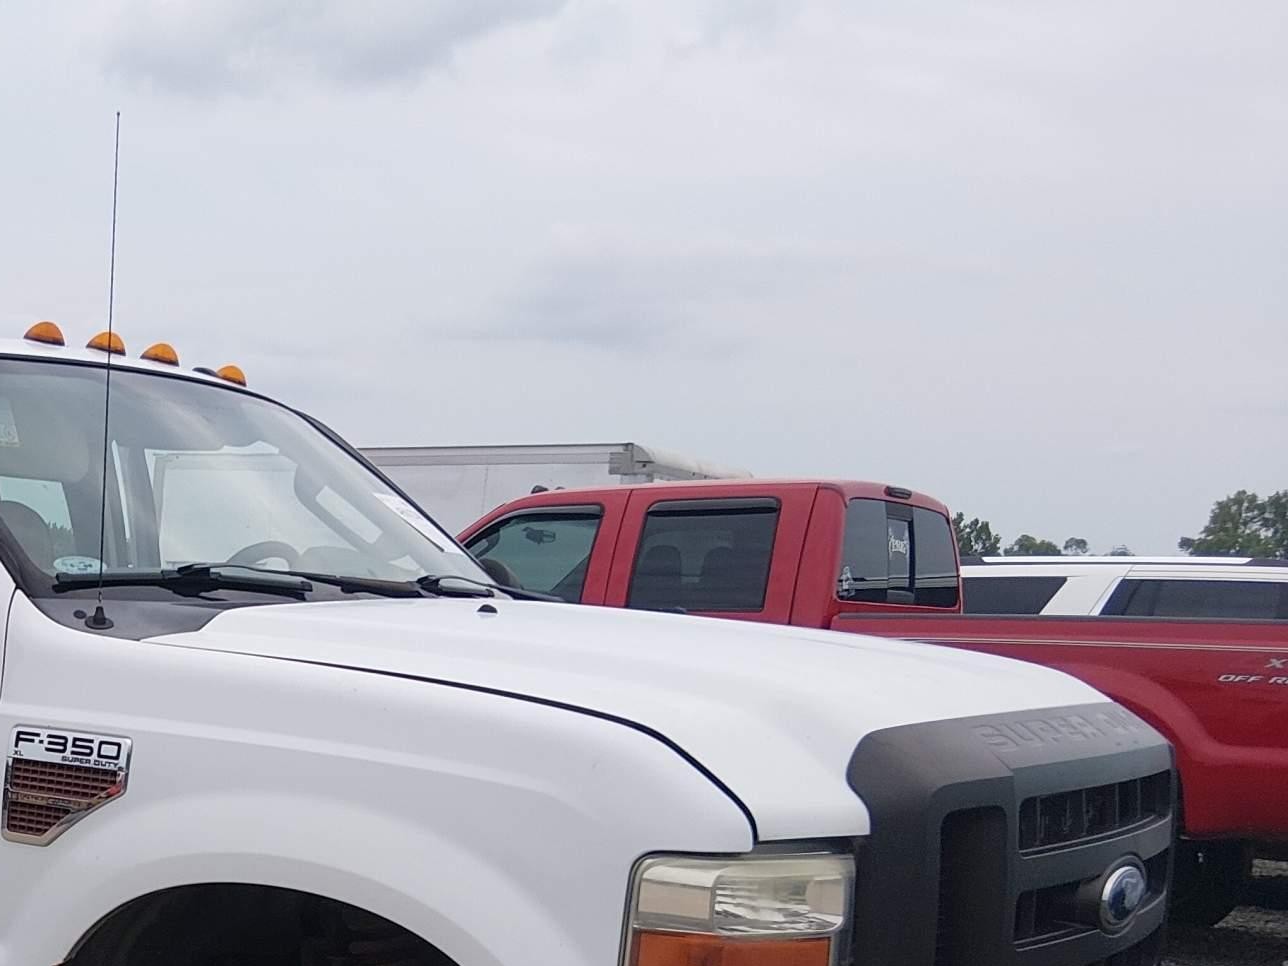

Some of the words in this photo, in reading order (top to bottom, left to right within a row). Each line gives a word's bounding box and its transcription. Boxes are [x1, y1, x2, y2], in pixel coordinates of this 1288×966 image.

[1218, 674, 1264, 683] OFF
[1268, 676, 1288, 685] R
[14, 730, 122, 761] F-350
[13, 749, 24, 757] XL
[61, 755, 91, 765] SUPER
[93, 759, 119, 768] DUTY
